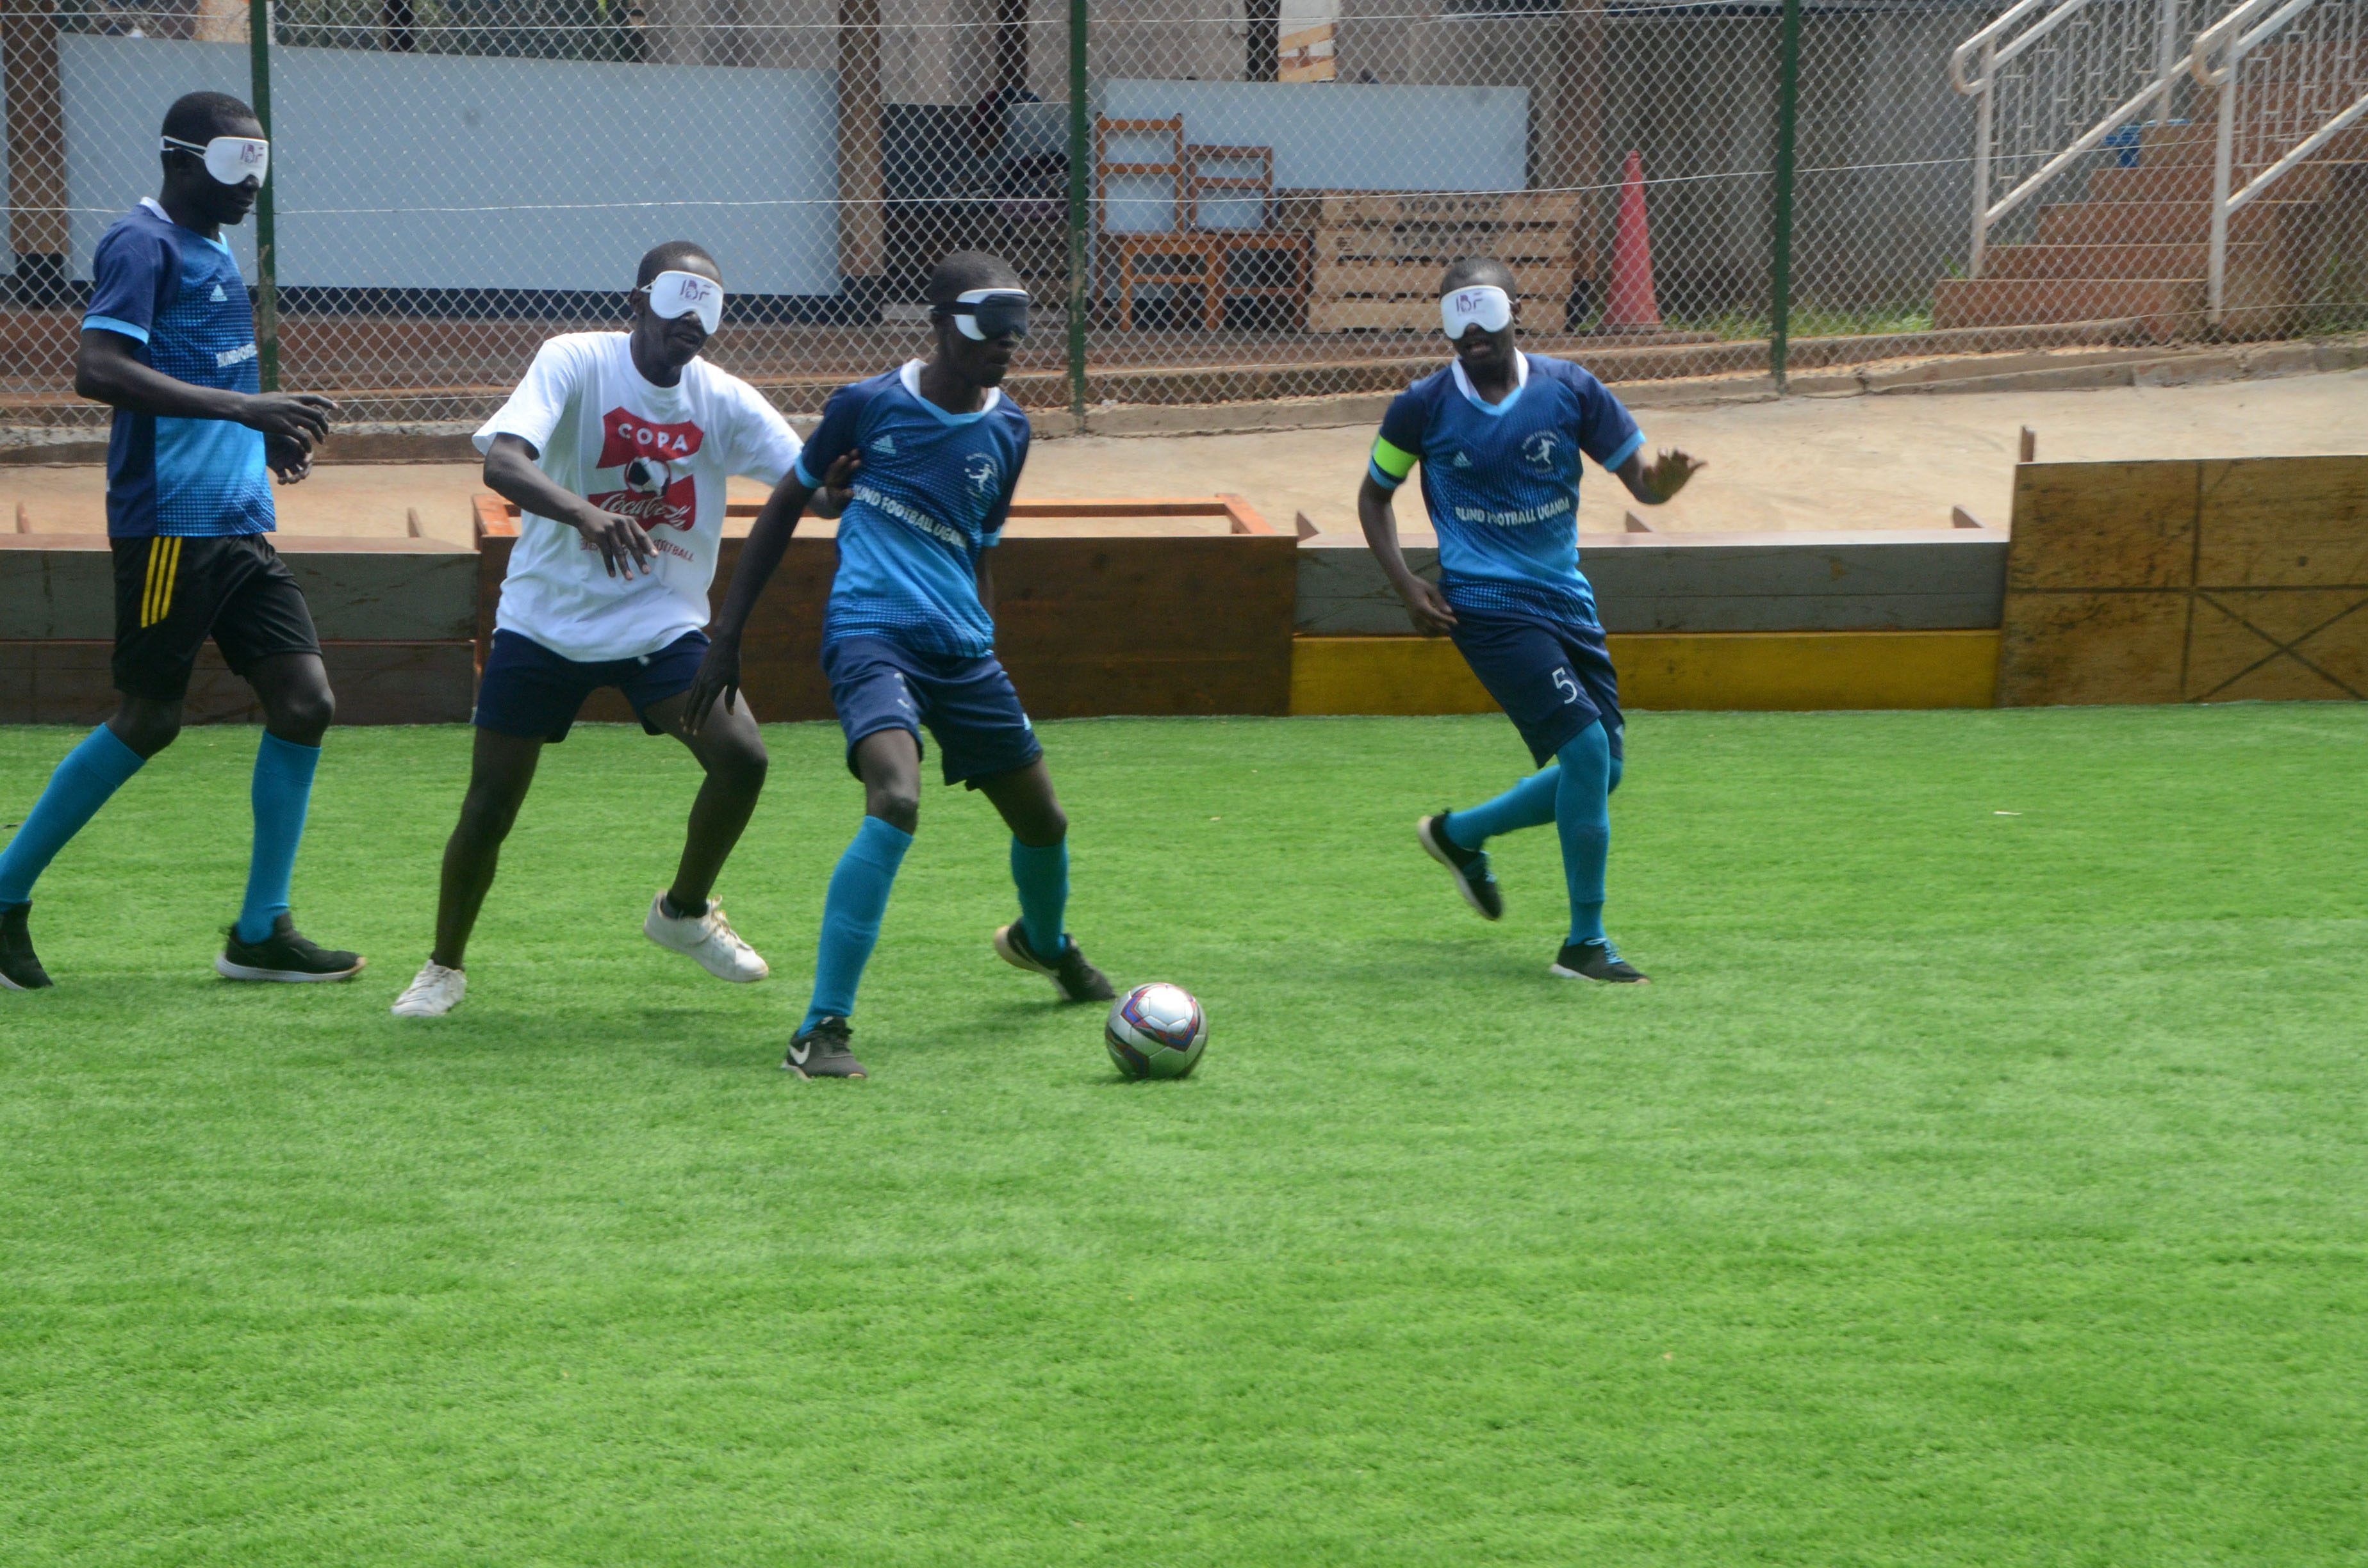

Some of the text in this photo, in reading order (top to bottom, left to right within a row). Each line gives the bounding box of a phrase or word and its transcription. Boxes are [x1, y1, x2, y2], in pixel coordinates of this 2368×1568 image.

[680, 279, 712, 301] IBF
[1456, 291, 1483, 313] IBF
[618, 423, 689, 452] COPA
[880, 496, 934, 534] FOOTBALL
[1454, 496, 1570, 527] BLIND FOOTBALL UGANDA
[1552, 667, 1577, 704] 5
